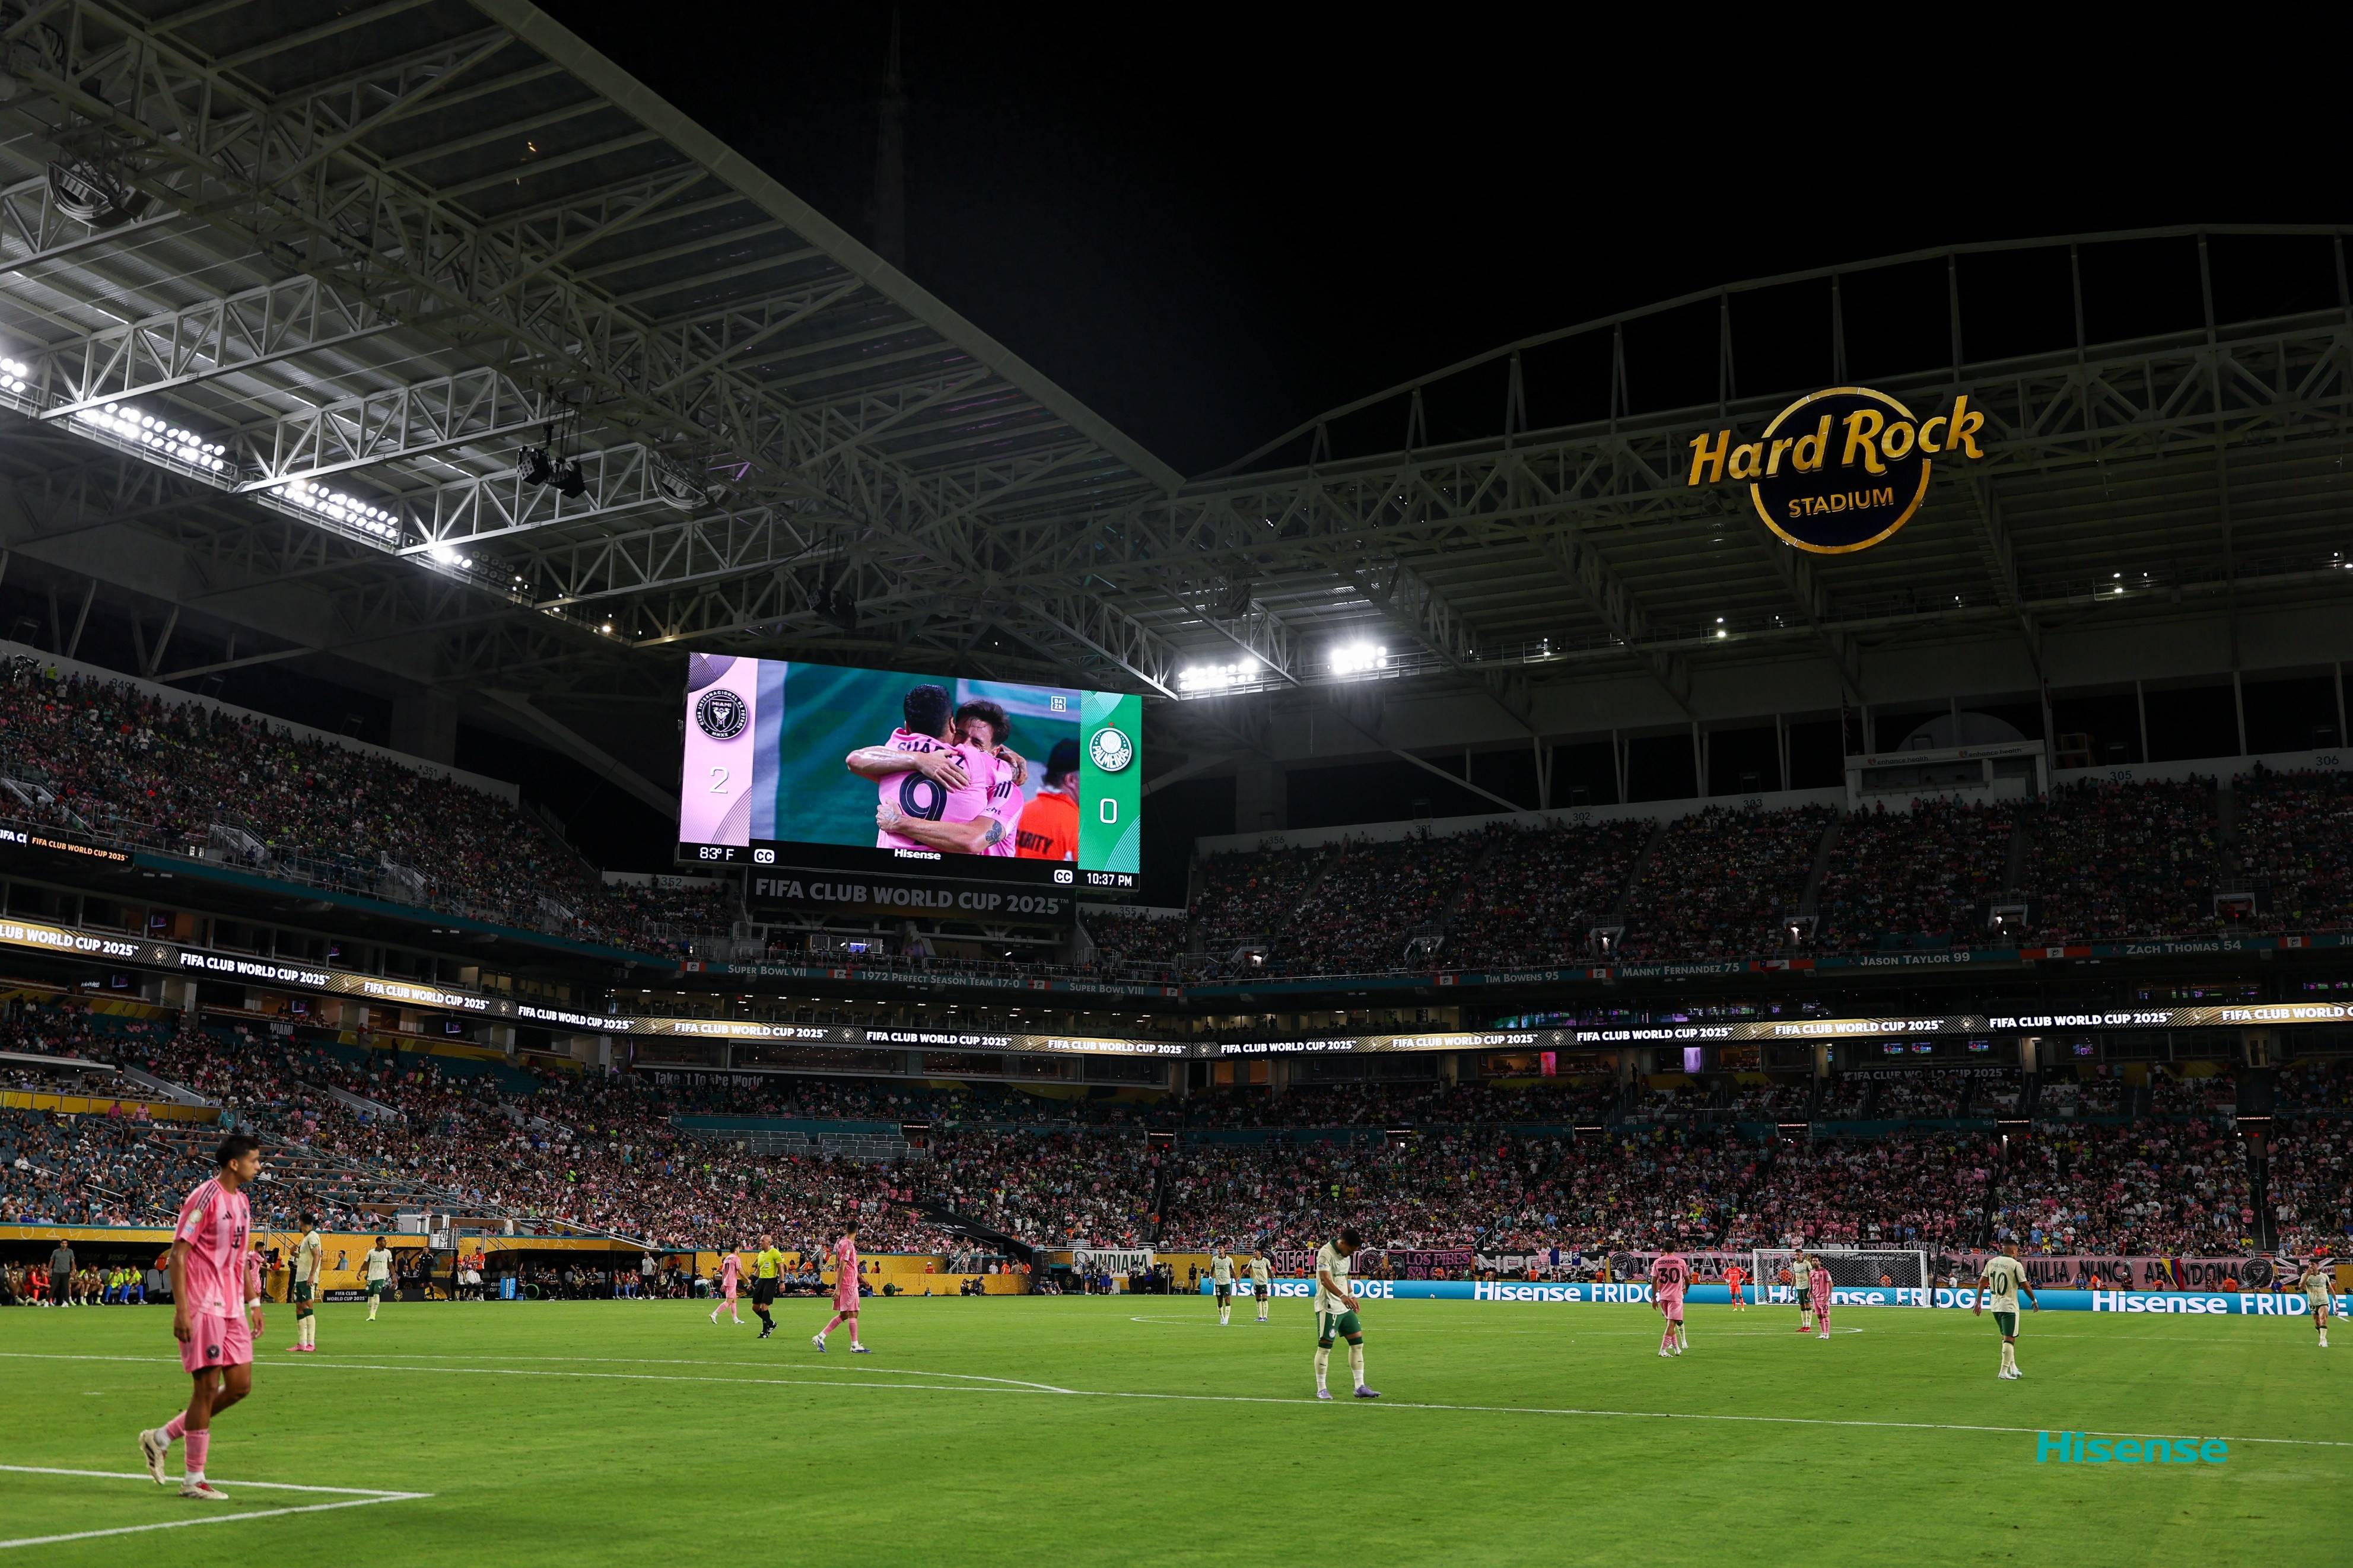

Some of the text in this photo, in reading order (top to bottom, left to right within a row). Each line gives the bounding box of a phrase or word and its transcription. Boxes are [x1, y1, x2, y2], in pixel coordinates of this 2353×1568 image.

[1688, 395, 1984, 486] Hard Rock
[1788, 486, 1894, 517] STADIUM
[1092, 745, 1129, 768] PALMEIRAS
[1907, 755, 1929, 764] health
[2316, 756, 2339, 765] 306
[709, 766, 729, 794] 2
[2110, 771, 2132, 781] 305
[899, 773, 947, 822] 9
[1100, 798, 1118, 824] 0
[1573, 812, 1591, 821] 302
[1268, 836, 1284, 844] 356
[32, 837, 107, 858] FIFA CLUB WORLD CUP
[726, 848, 734, 860] F
[894, 848, 942, 860] Hisense
[755, 851, 774, 862] CC
[662, 877, 682, 886] 352
[1055, 871, 1072, 882] CC
[1087, 873, 1132, 886] 10:37 PM
[756, 879, 804, 898] FIFA
[809, 883, 867, 902] CLUB
[873, 886, 953, 908] WORLD
[958, 892, 1001, 911] CUP
[27, 929, 73, 947] WORLD
[75, 937, 101, 950] CUP
[2126, 940, 2241, 955] ZACH THOMAS 54
[1860, 952, 1970, 966] JASON TAYLOR 99
[180, 953, 205, 968] FIFA
[206, 958, 234, 972] CLUB
[237, 962, 276, 978] WORLD
[278, 968, 298, 981] CUP
[728, 965, 806, 977] SUPER BOWL VII
[1622, 962, 1740, 977] MANNY FERNANDEZ 75
[861, 971, 1019, 988] 1972 PERFECT SEASON TEAM 17-0
[1484, 972, 1559, 983] TIM BOWENS 95
[364, 982, 384, 994] FIFA
[386, 985, 410, 998] CLUB
[411, 989, 444, 1003] WORLD
[445, 995, 463, 1006] CUP
[1070, 983, 1144, 995] SUPER BOWL VIII
[519, 1006, 536, 1017] FIFA
[537, 1009, 557, 1020] CLUB
[558, 1012, 586, 1025] WORLD
[587, 1017, 603, 1027] CUP
[2222, 1010, 2252, 1020] FIFA
[2255, 1008, 2290, 1019] CLUB
[2292, 1006, 2344, 1018] WORLD
[1990, 1017, 2017, 1028] FIFA
[2019, 1016, 2052, 1028] CLUB
[2055, 1014, 2102, 1026] WORLD
[2104, 1013, 2131, 1025] CUP
[270, 1022, 294, 1035] MIAMI
[675, 1023, 698, 1032] FIFA
[700, 1024, 729, 1033] CLUB
[730, 1025, 771, 1036] WORLD
[772, 1028, 795, 1036] CUP
[1577, 1032, 1600, 1042] FIFA
[1602, 1031, 1630, 1041] CLUB
[1632, 1029, 1673, 1039] WORLD
[1675, 1028, 1698, 1038] CUP
[1775, 1025, 1801, 1035] FIFA
[1802, 1024, 1833, 1034] CLUB
[1835, 1023, 1879, 1033] WORLD
[1881, 1022, 1906, 1031] CUP
[866, 1031, 891, 1041] FIFA
[891, 1032, 918, 1042] CLUB
[920, 1034, 958, 1044] WORLD
[959, 1036, 980, 1045] CUP
[1392, 1039, 1414, 1048] FIFA
[1416, 1038, 1442, 1047] CLUB
[1443, 1036, 1482, 1046] WORLD
[1483, 1035, 1505, 1045] CUP
[1048, 1040, 1069, 1049] FIFA
[1071, 1041, 1097, 1050] CLUB
[1098, 1042, 1134, 1052] WORLD
[1136, 1044, 1156, 1052] CUP
[1221, 1044, 1241, 1054] FIFA
[1243, 1043, 1267, 1052] CLUB
[1269, 1042, 1304, 1052] WORLD
[1305, 1041, 1326, 1051] CUP
[654, 1072, 764, 1087] Take To World
[1094, 1253, 1147, 1273] INDIANA
[1277, 1250, 1311, 1273] SIEGE
[1406, 1252, 1430, 1265] LOS
[1433, 1252, 1471, 1265] PIBES
[1658, 1268, 1680, 1284] 30
[2145, 1260, 2240, 1286] ABNDONA
[1990, 1271, 2008, 1296] 10
[1474, 1281, 1661, 1303] Hisense FRIDG
[2093, 1290, 2349, 1316] Hisense FRIDE
